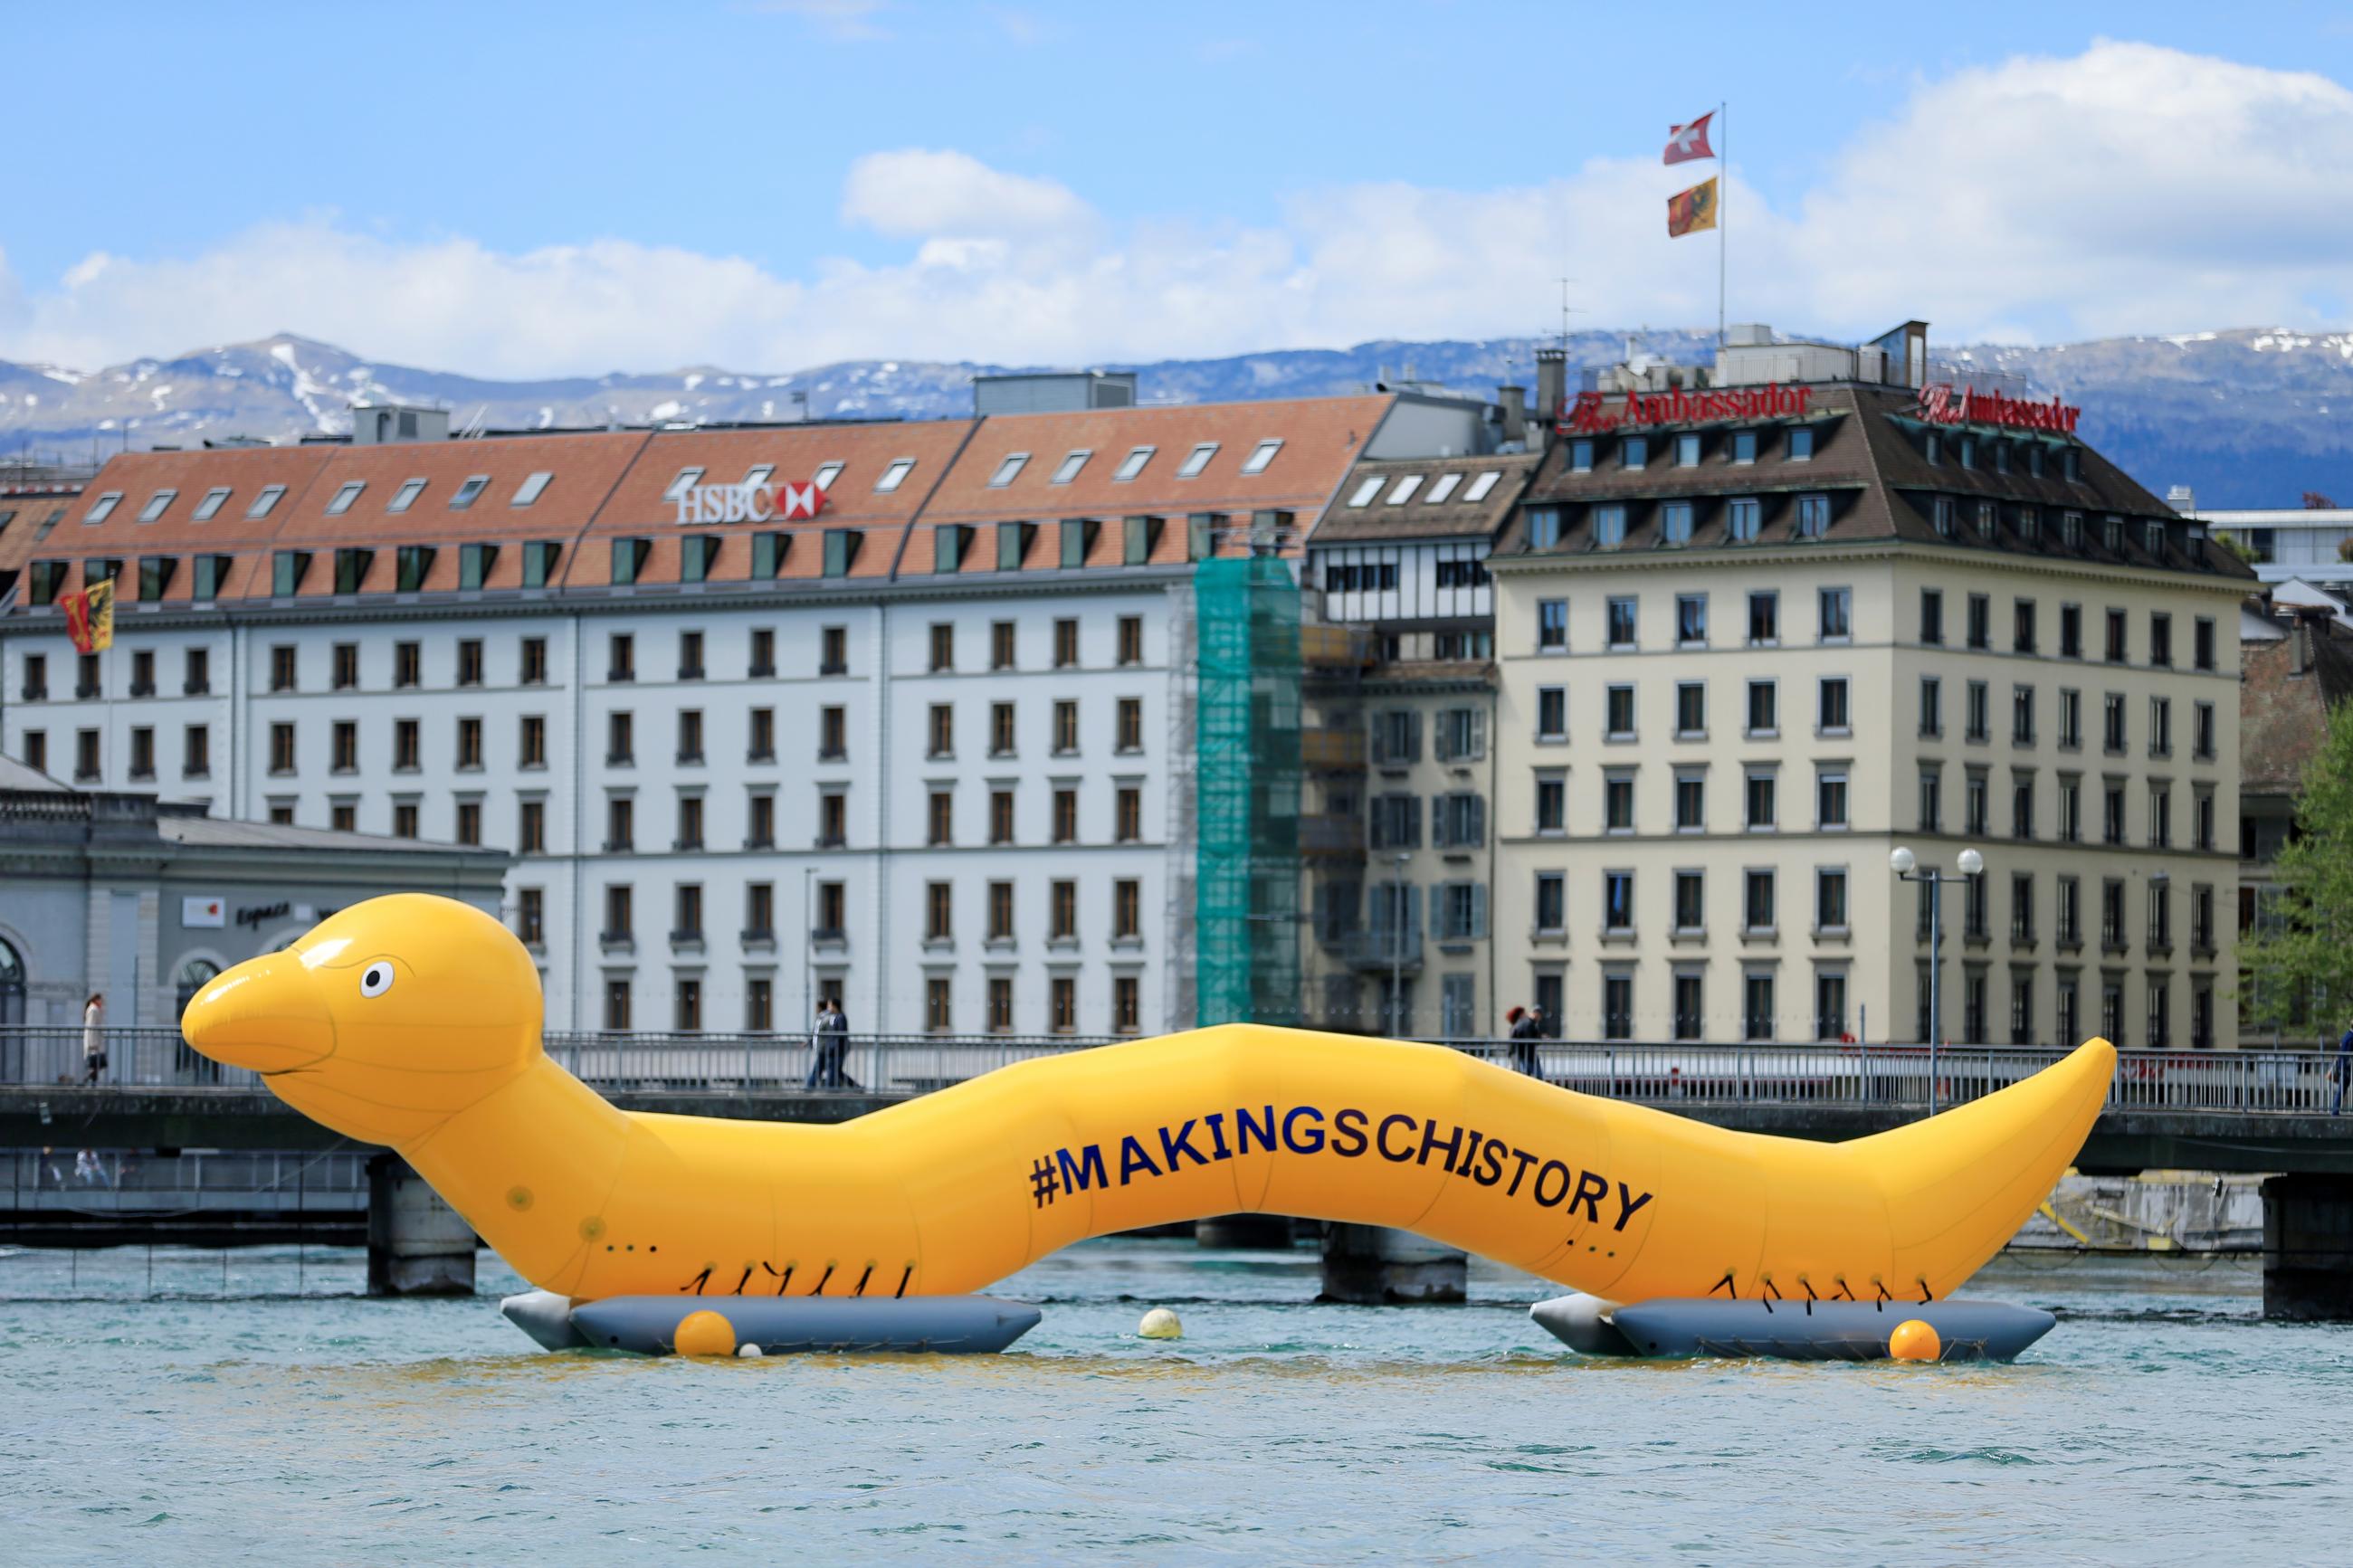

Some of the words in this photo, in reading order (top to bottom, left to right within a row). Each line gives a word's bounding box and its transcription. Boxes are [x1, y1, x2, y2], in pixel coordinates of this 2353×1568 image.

[1621, 381, 1810, 425] Ambassador
[675, 482, 772, 525] HSBC
[1030, 1105, 1653, 1232] #MAKINGSCHISTORY
